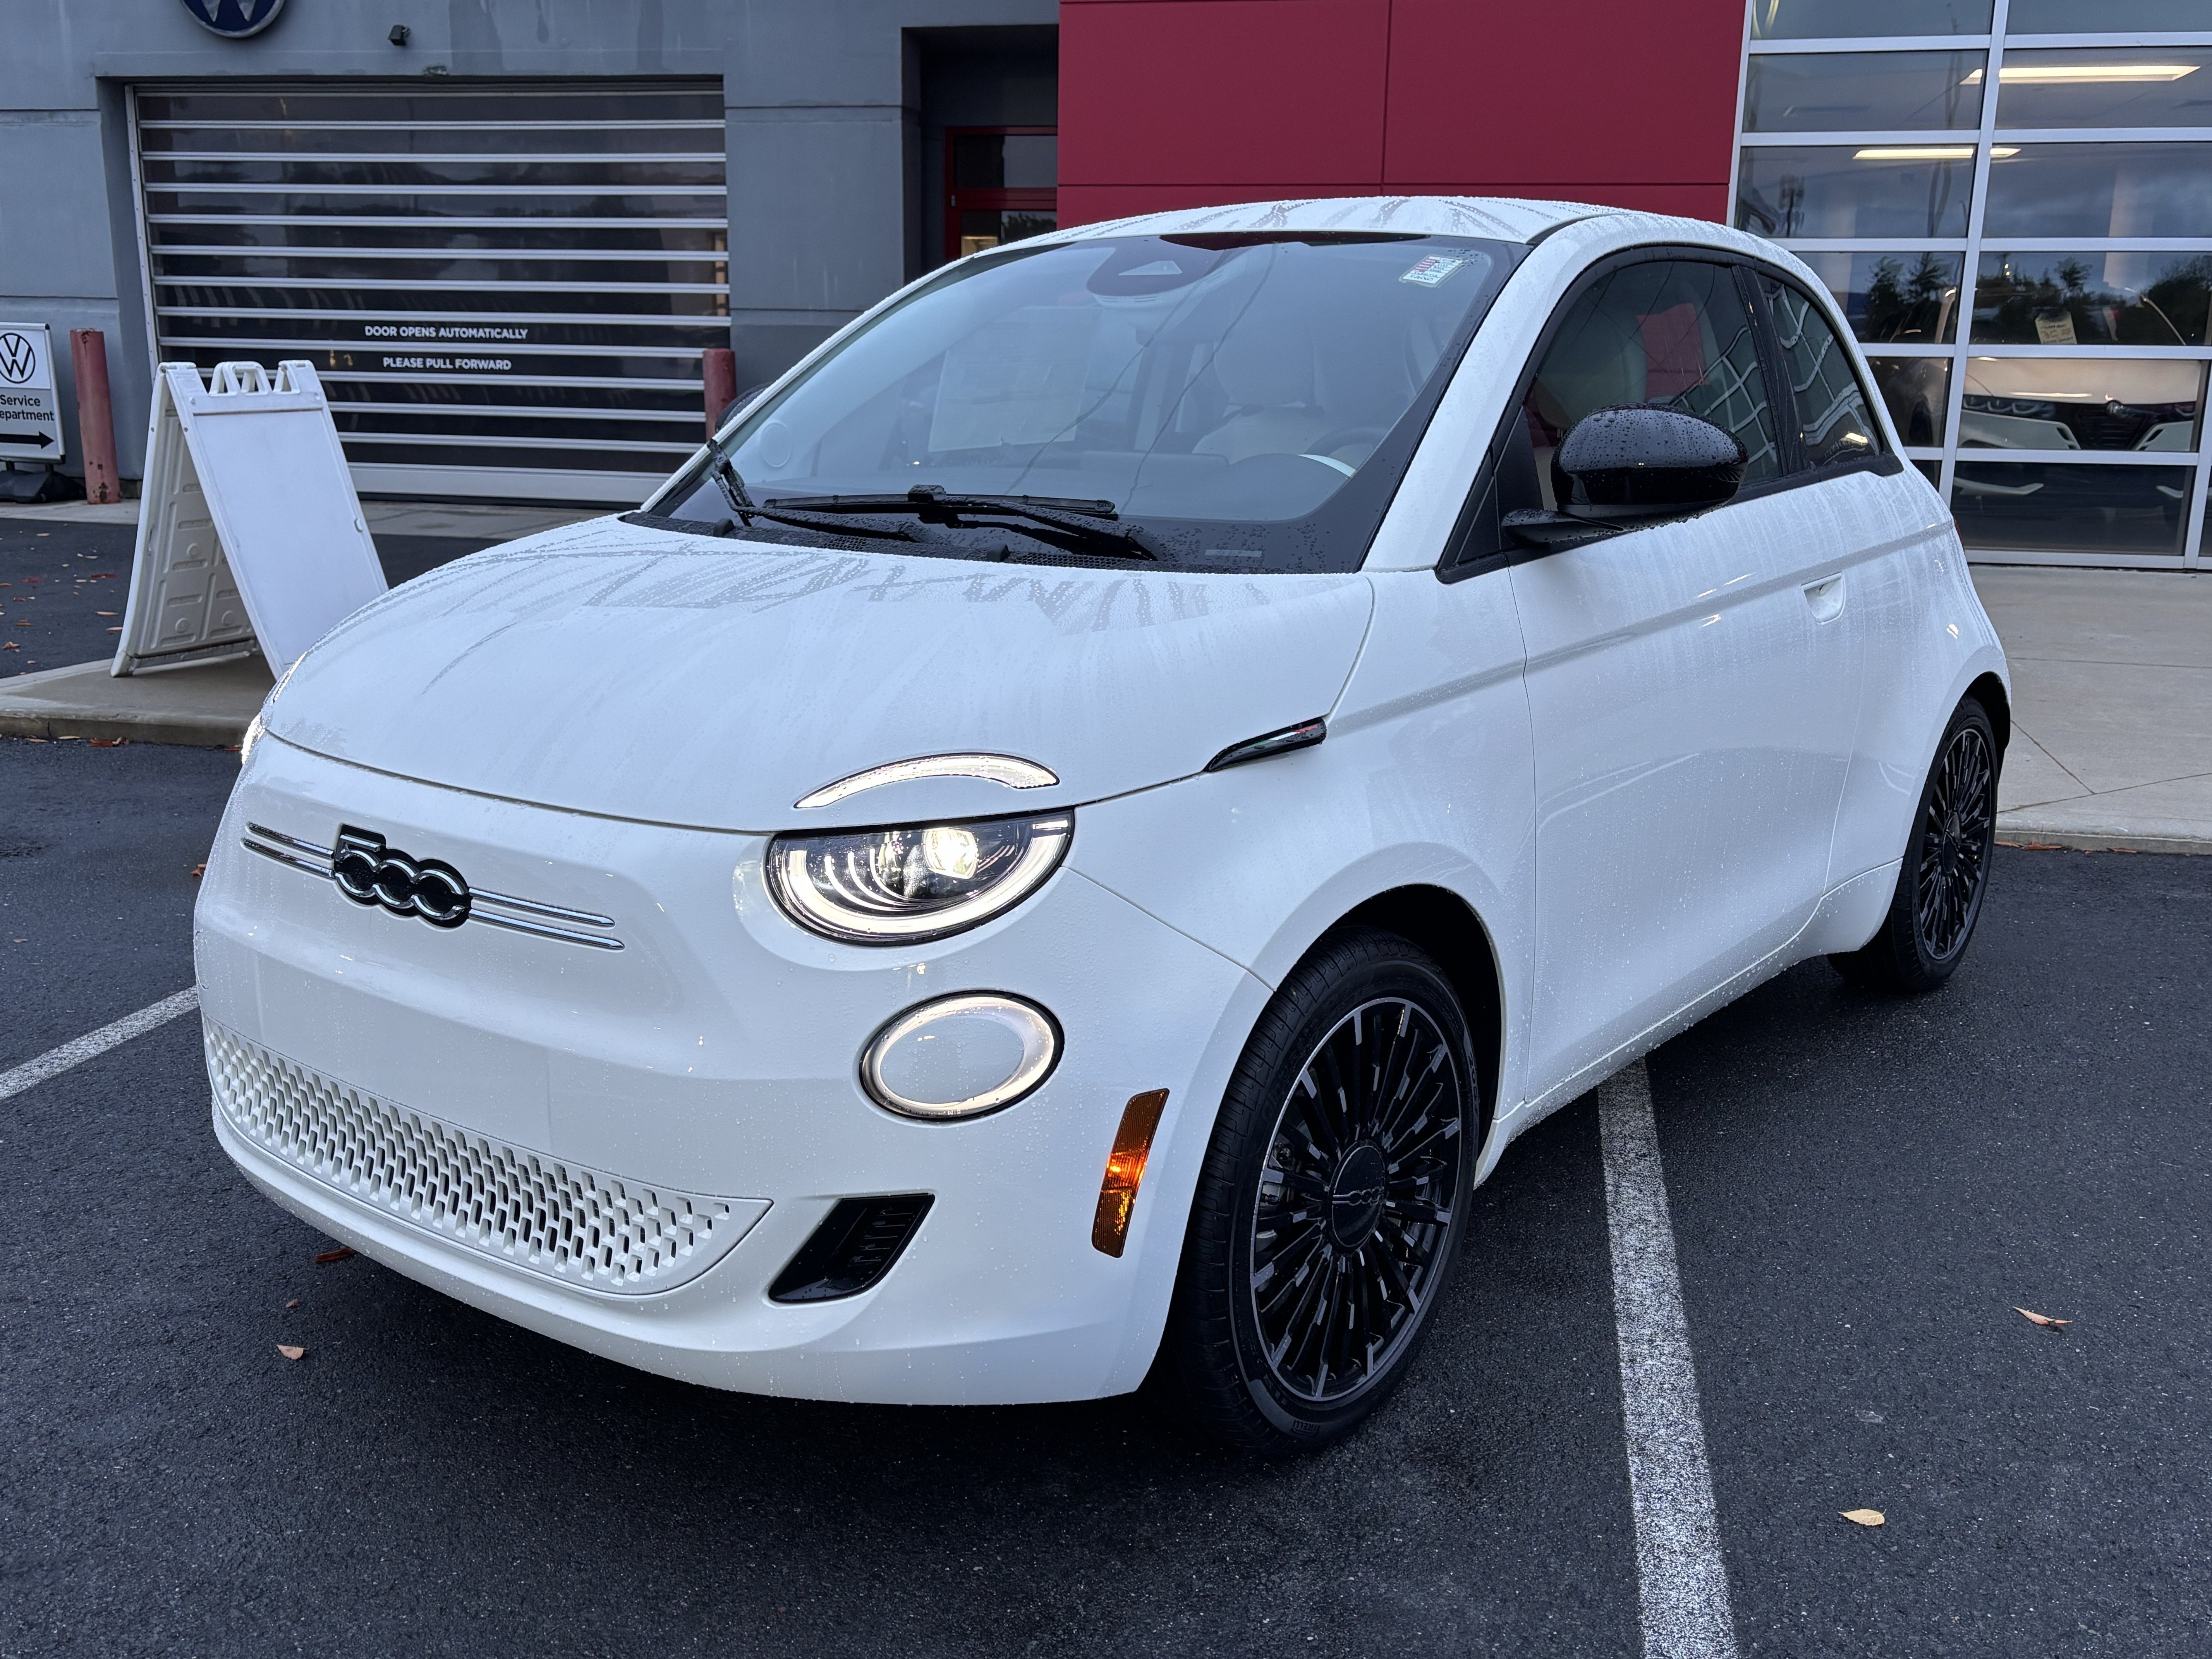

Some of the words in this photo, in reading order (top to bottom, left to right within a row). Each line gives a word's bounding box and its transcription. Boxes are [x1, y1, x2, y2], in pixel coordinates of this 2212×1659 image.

[365, 326, 397, 336] DOOR
[400, 326, 436, 337] OPENS
[438, 327, 528, 339] AUTOMATICALLY
[383, 357, 424, 368] PLEASE
[426, 358, 453, 369] PULL
[455, 359, 512, 370] FORWARD
[0, 394, 41, 407] Service
[334, 824, 469, 928] 500
